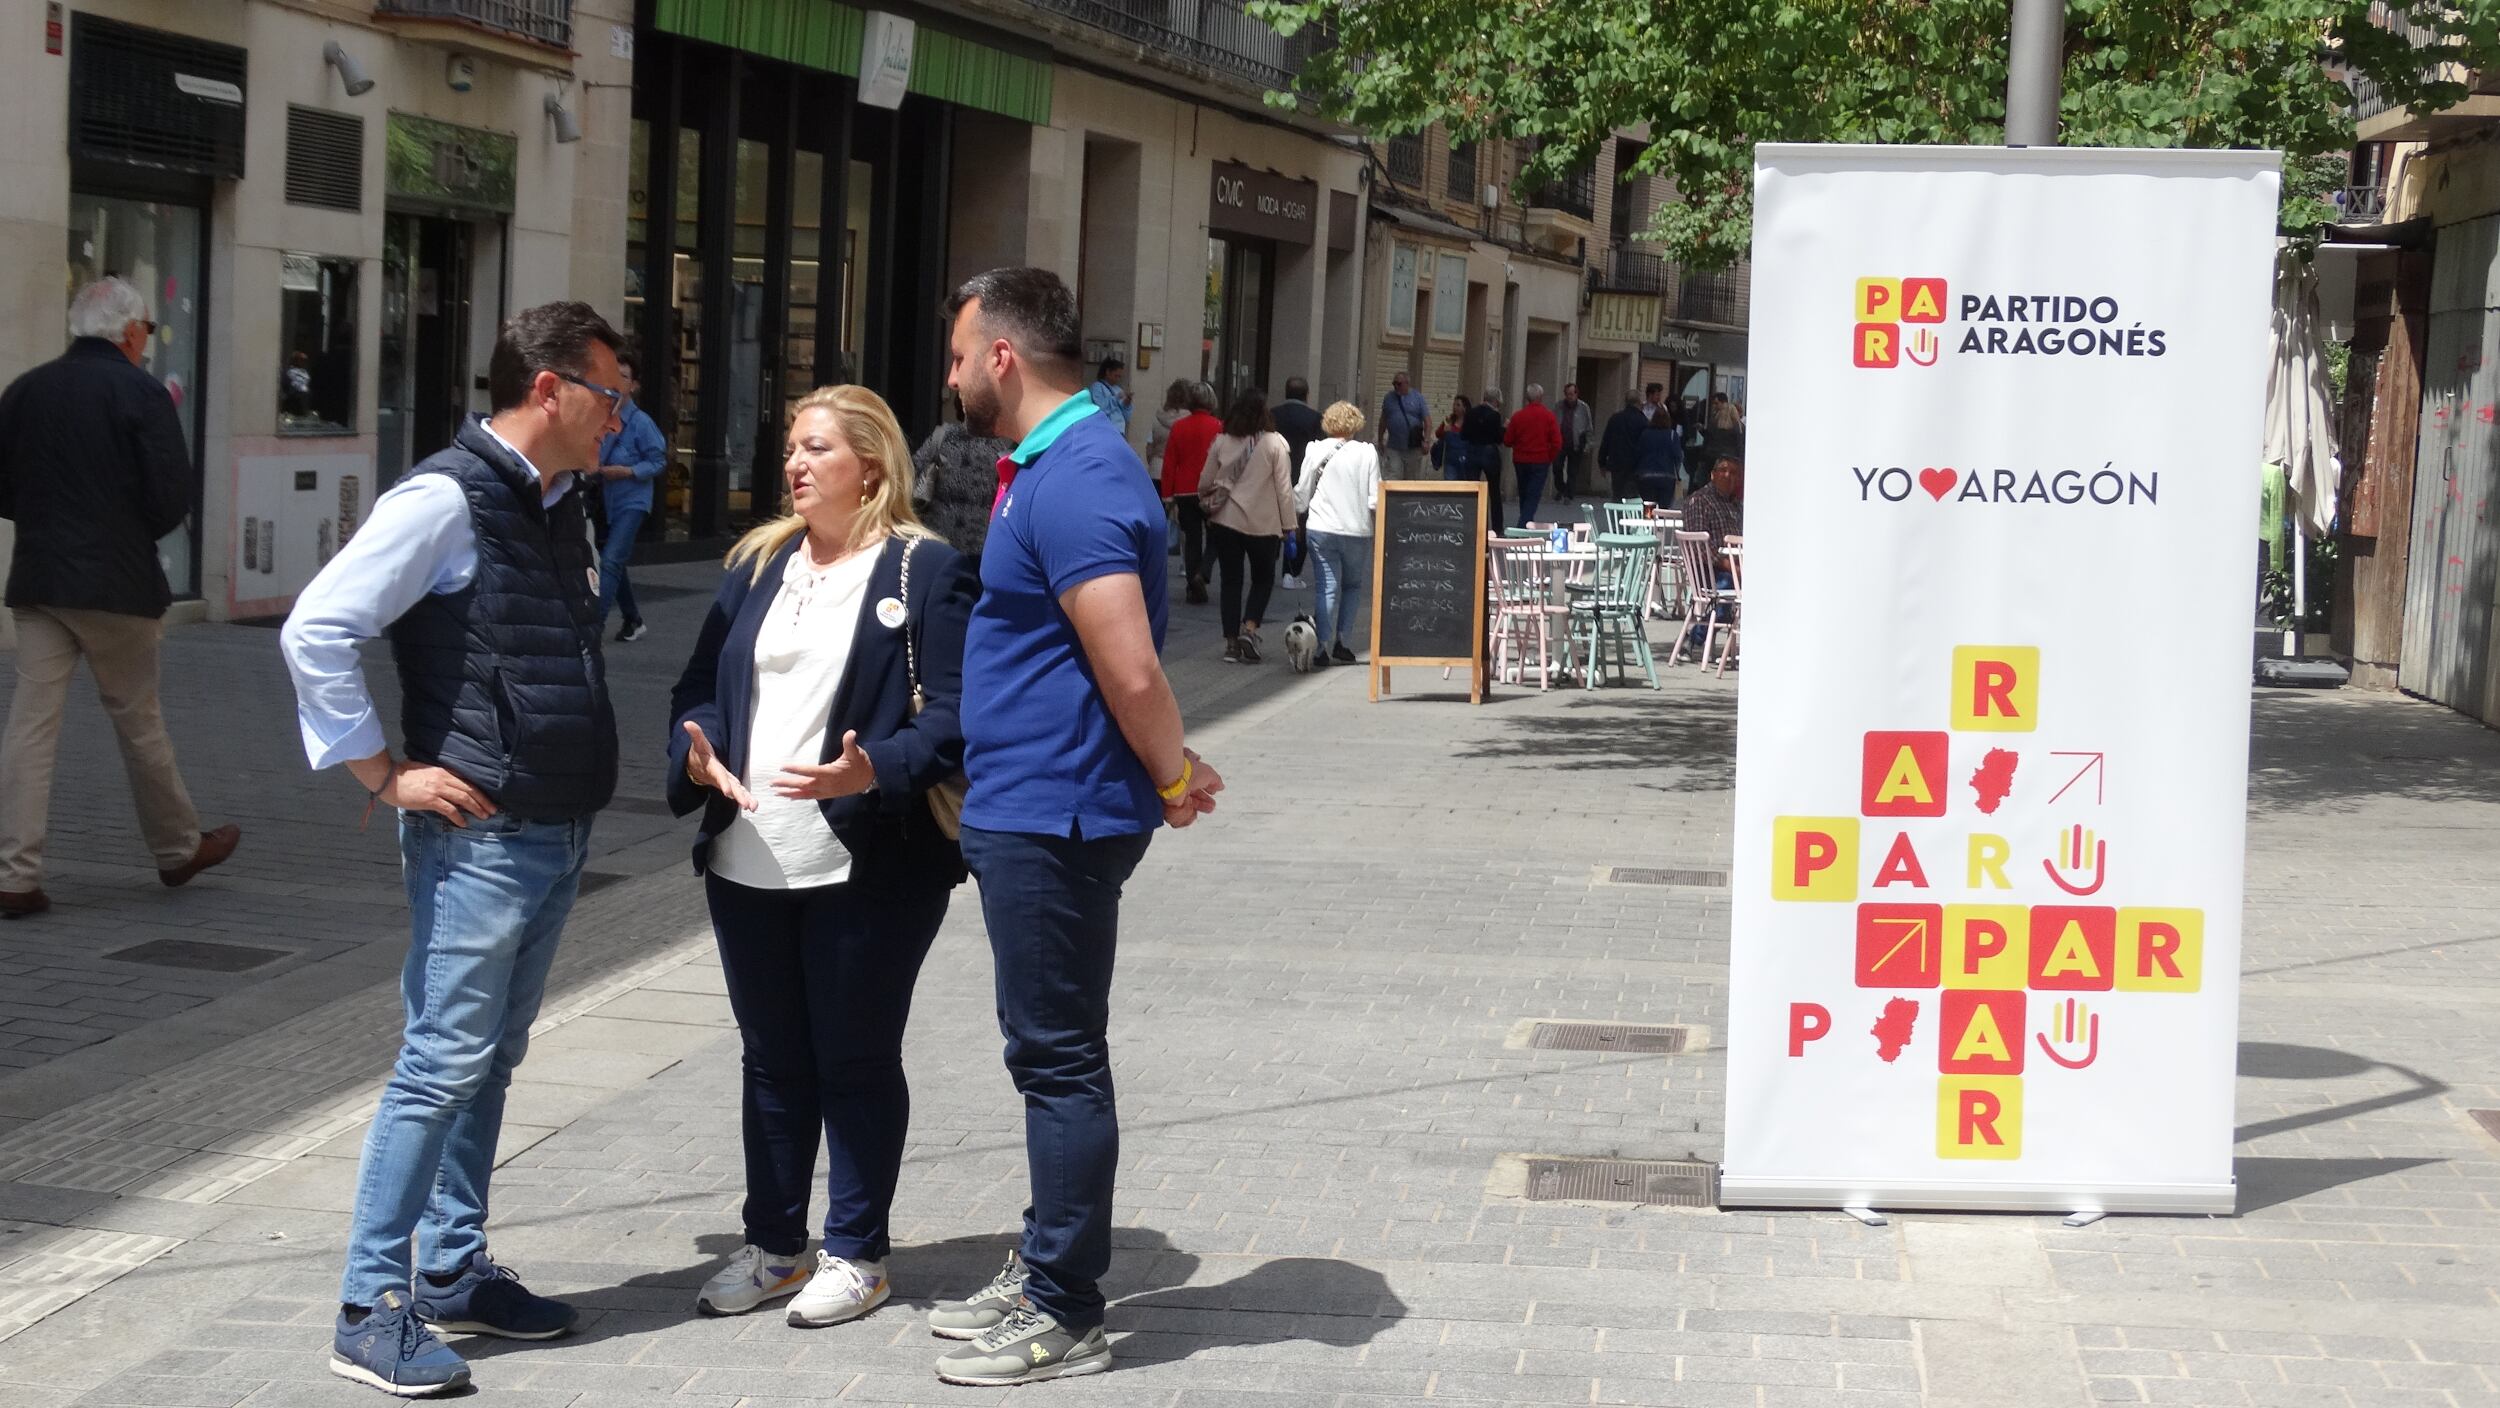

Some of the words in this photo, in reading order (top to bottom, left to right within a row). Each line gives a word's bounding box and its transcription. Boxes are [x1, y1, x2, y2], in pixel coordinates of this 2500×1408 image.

[1217, 175, 1244, 208] CMC
[1258, 195, 1280, 215] MODA
[1281, 200, 1306, 220] HOGAR
[1593, 294, 1655, 331] ASCASO
[1960, 294, 2119, 323] PARTIDO
[1958, 321, 2167, 357] ARAGONÉS
[1852, 467, 1912, 502] YO
[1957, 461, 2158, 505] ARAGÓN
[1402, 501, 1464, 520] TARTAS
